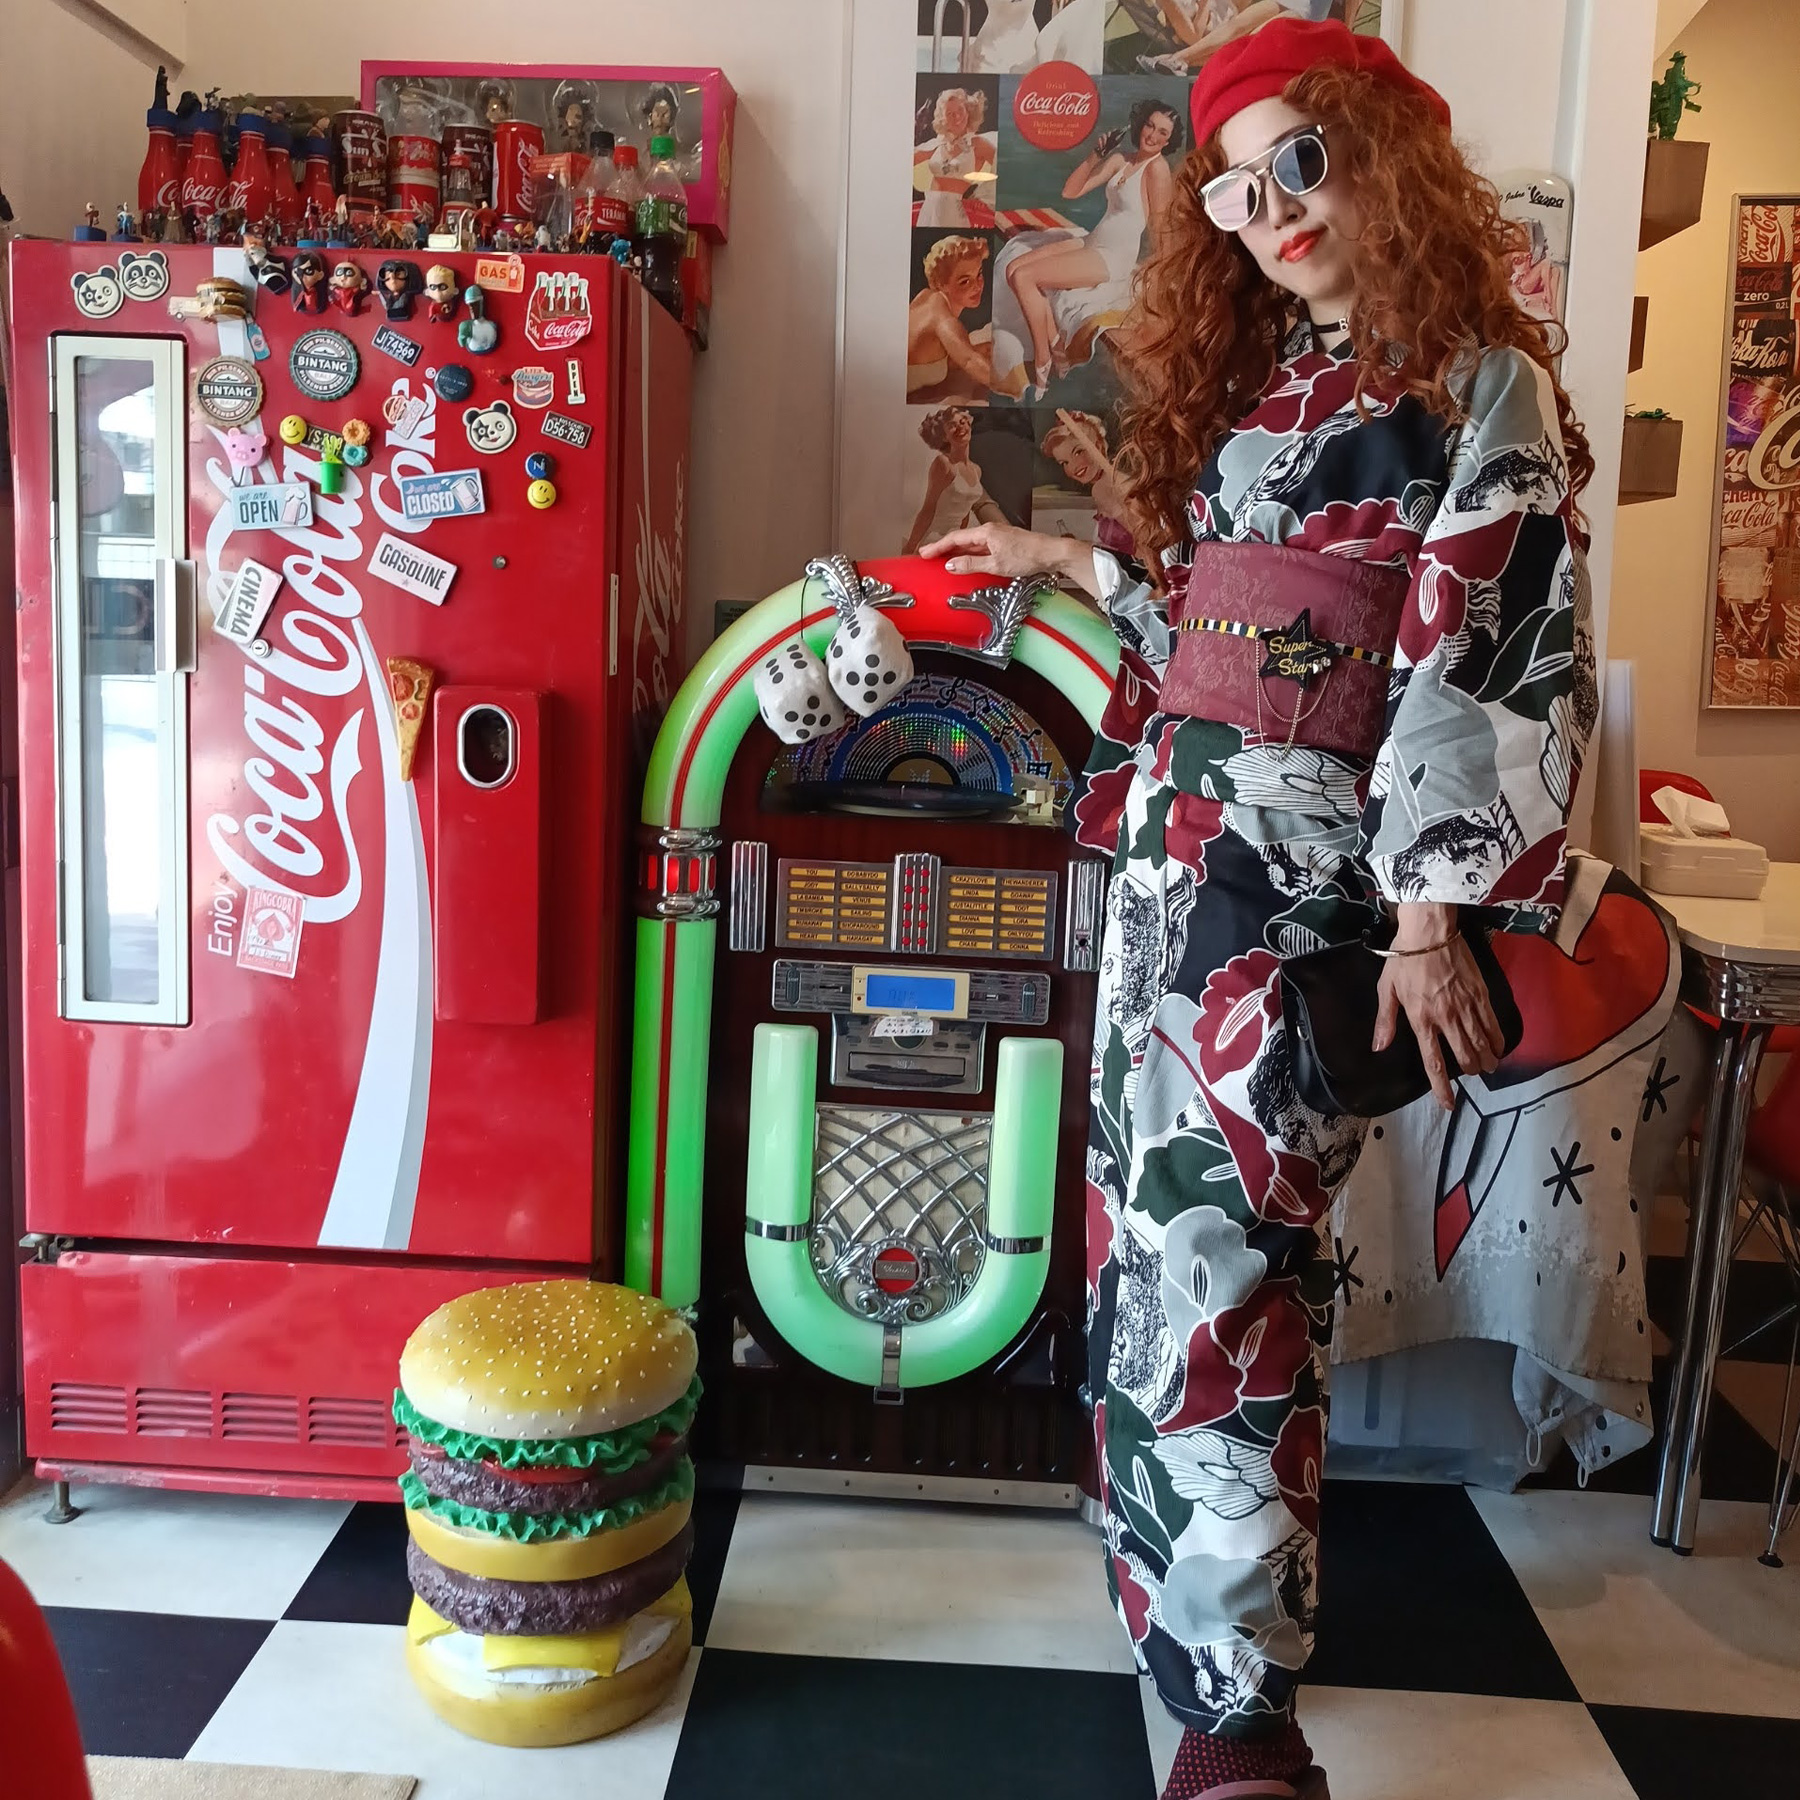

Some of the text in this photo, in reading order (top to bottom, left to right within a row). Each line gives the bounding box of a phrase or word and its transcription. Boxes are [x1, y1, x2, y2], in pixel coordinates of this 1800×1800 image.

[1020, 92, 1093, 115] Coca-Cola
[1528, 185, 1564, 208] Vespa
[1749, 205, 1778, 263] Coca-Col
[480, 265, 507, 279] GAS
[1743, 292, 1770, 302] zero
[544, 320, 588, 340] Coca-Cola
[298, 356, 348, 372] BINTANG
[202, 384, 252, 397] BINTANG
[570, 363, 579, 397] OPEN
[253, 492, 268, 500] are
[406, 490, 456, 516] CLOSED
[240, 500, 279, 524] OPEN
[379, 543, 447, 591] GASOLINE
[230, 565, 263, 638] CINEMA
[1269, 636, 1312, 658] Super
[205, 424, 364, 923] Coca-Cola
[1278, 658, 1312, 676] Star
[208, 881, 238, 957] Enjoy
